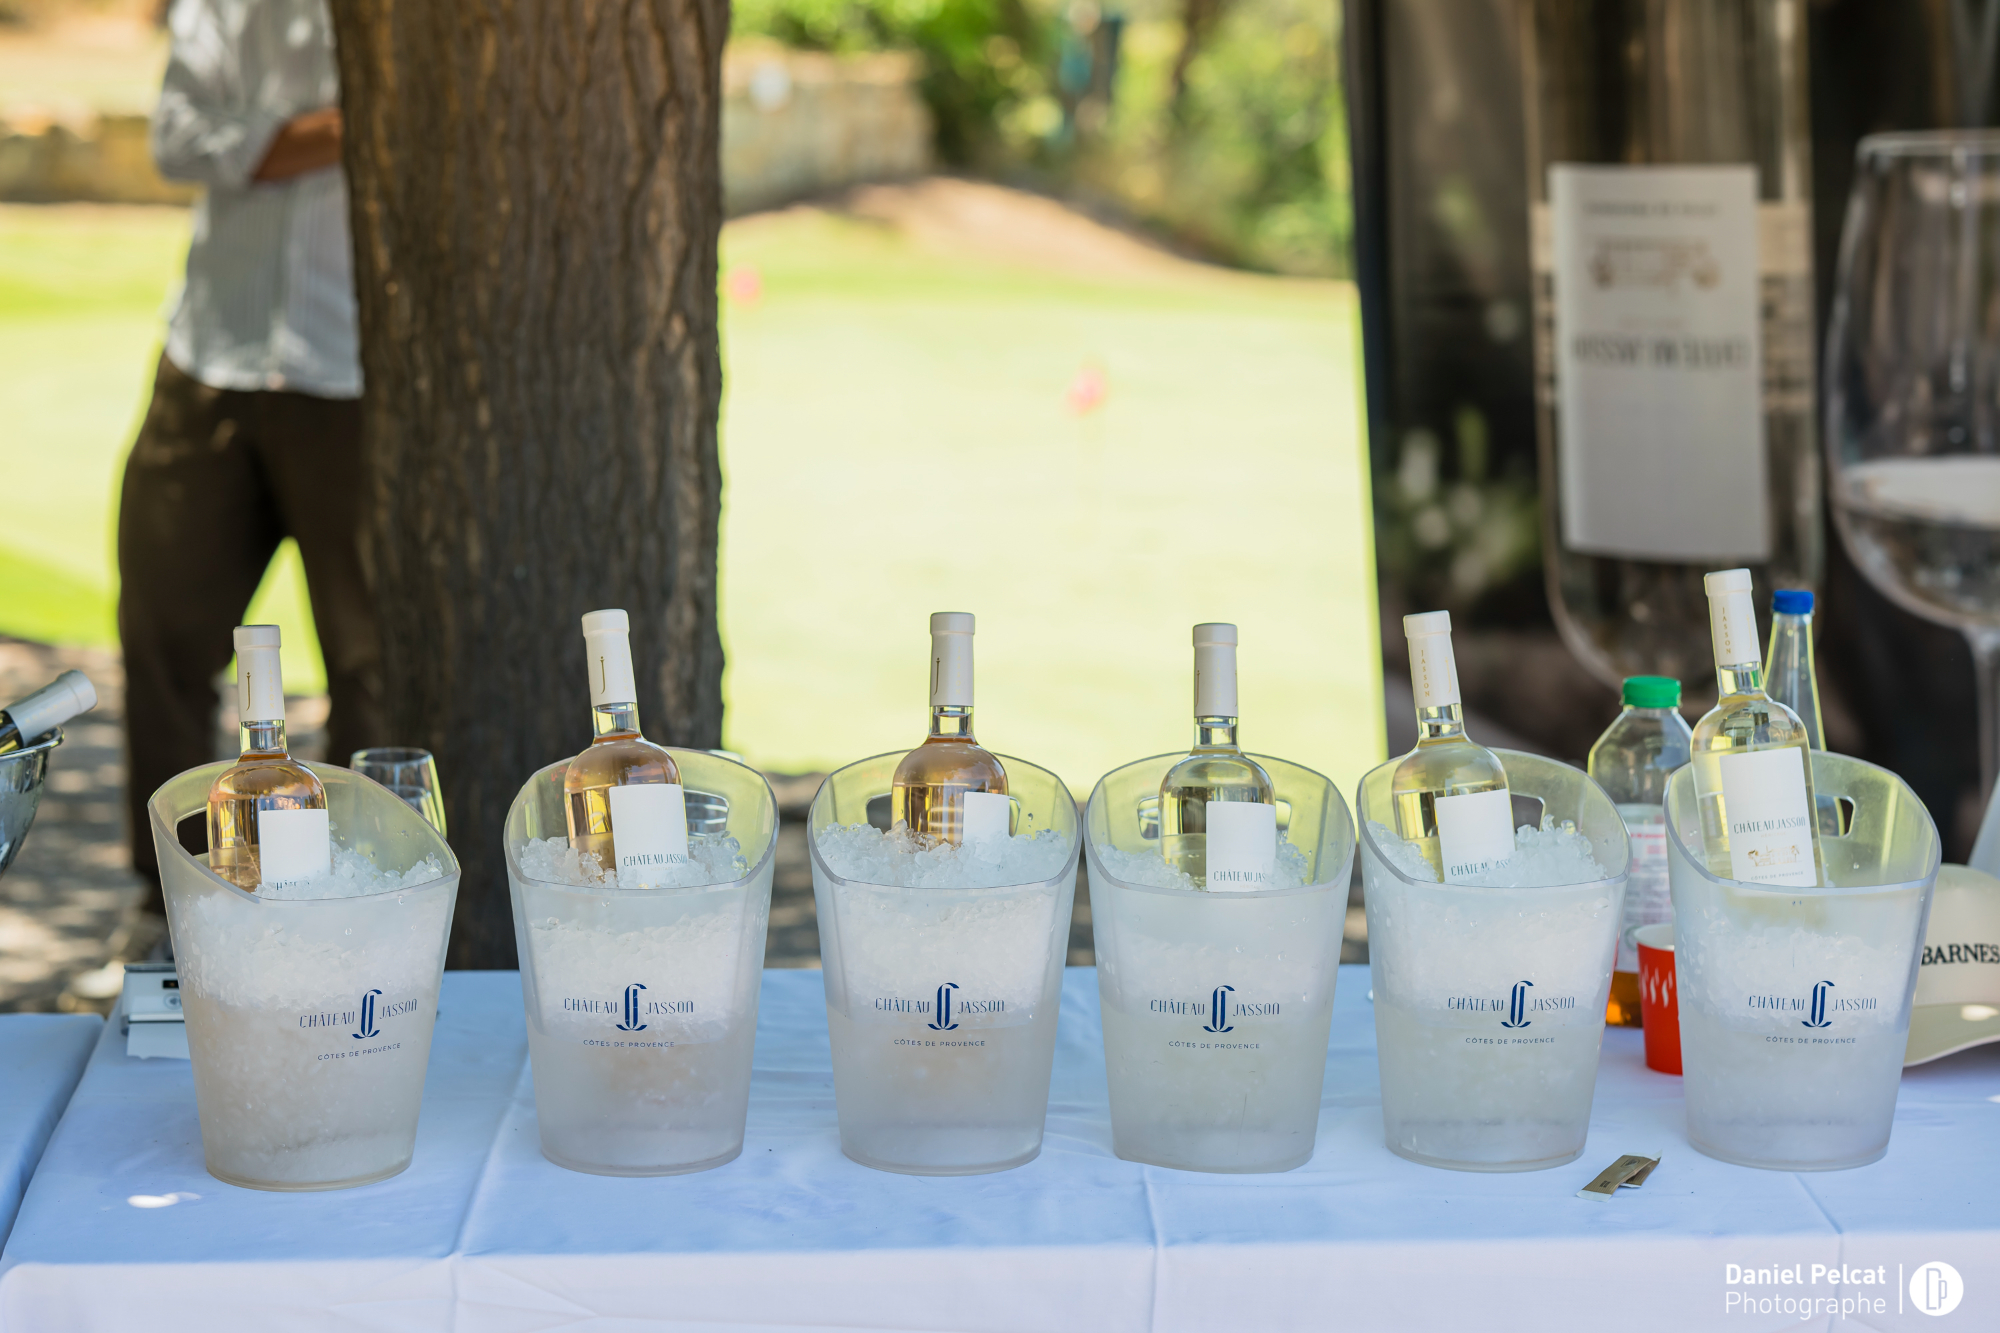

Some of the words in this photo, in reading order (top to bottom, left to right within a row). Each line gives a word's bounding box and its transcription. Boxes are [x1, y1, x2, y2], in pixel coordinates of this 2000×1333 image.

[1722, 606, 1731, 655] JASSON
[1420, 649, 1430, 698] JASSON
[1733, 820, 1775, 834] CHÂTEAU
[1776, 816, 1806, 830] JASSON
[623, 852, 664, 867] CHÂTEAU
[1213, 868, 1253, 882] CHÂTEAU
[1921, 943, 2000, 967] BARNES
[564, 997, 618, 1015] CHÂTEAU
[645, 1000, 694, 1015] JASSON
[875, 996, 930, 1014] CHÂTEAU
[957, 1000, 1005, 1015] JASSON
[1150, 998, 1205, 1016] CHÂTEAU
[1232, 1002, 1280, 1017] JASSON
[1447, 995, 1504, 1012] CHÂTEAU
[1530, 996, 1575, 1012] JASSON
[1748, 994, 1805, 1011] CHÂTEAU
[1831, 997, 1877, 1012] JASSON
[299, 1011, 355, 1029] CHÂTEAU
[379, 998, 418, 1020] JASSON
[583, 1039, 611, 1047] CÔTES
[1168, 1040, 1197, 1048] CÔTES
[1465, 1037, 1494, 1045] CÔTES
[1511, 1037, 1555, 1045] PROVENCE
[1765, 1036, 1794, 1044] CÔTES
[317, 1051, 346, 1061] CÔTES
[349, 1050, 359, 1058] DE
[362, 1042, 402, 1056] PROVENCE
